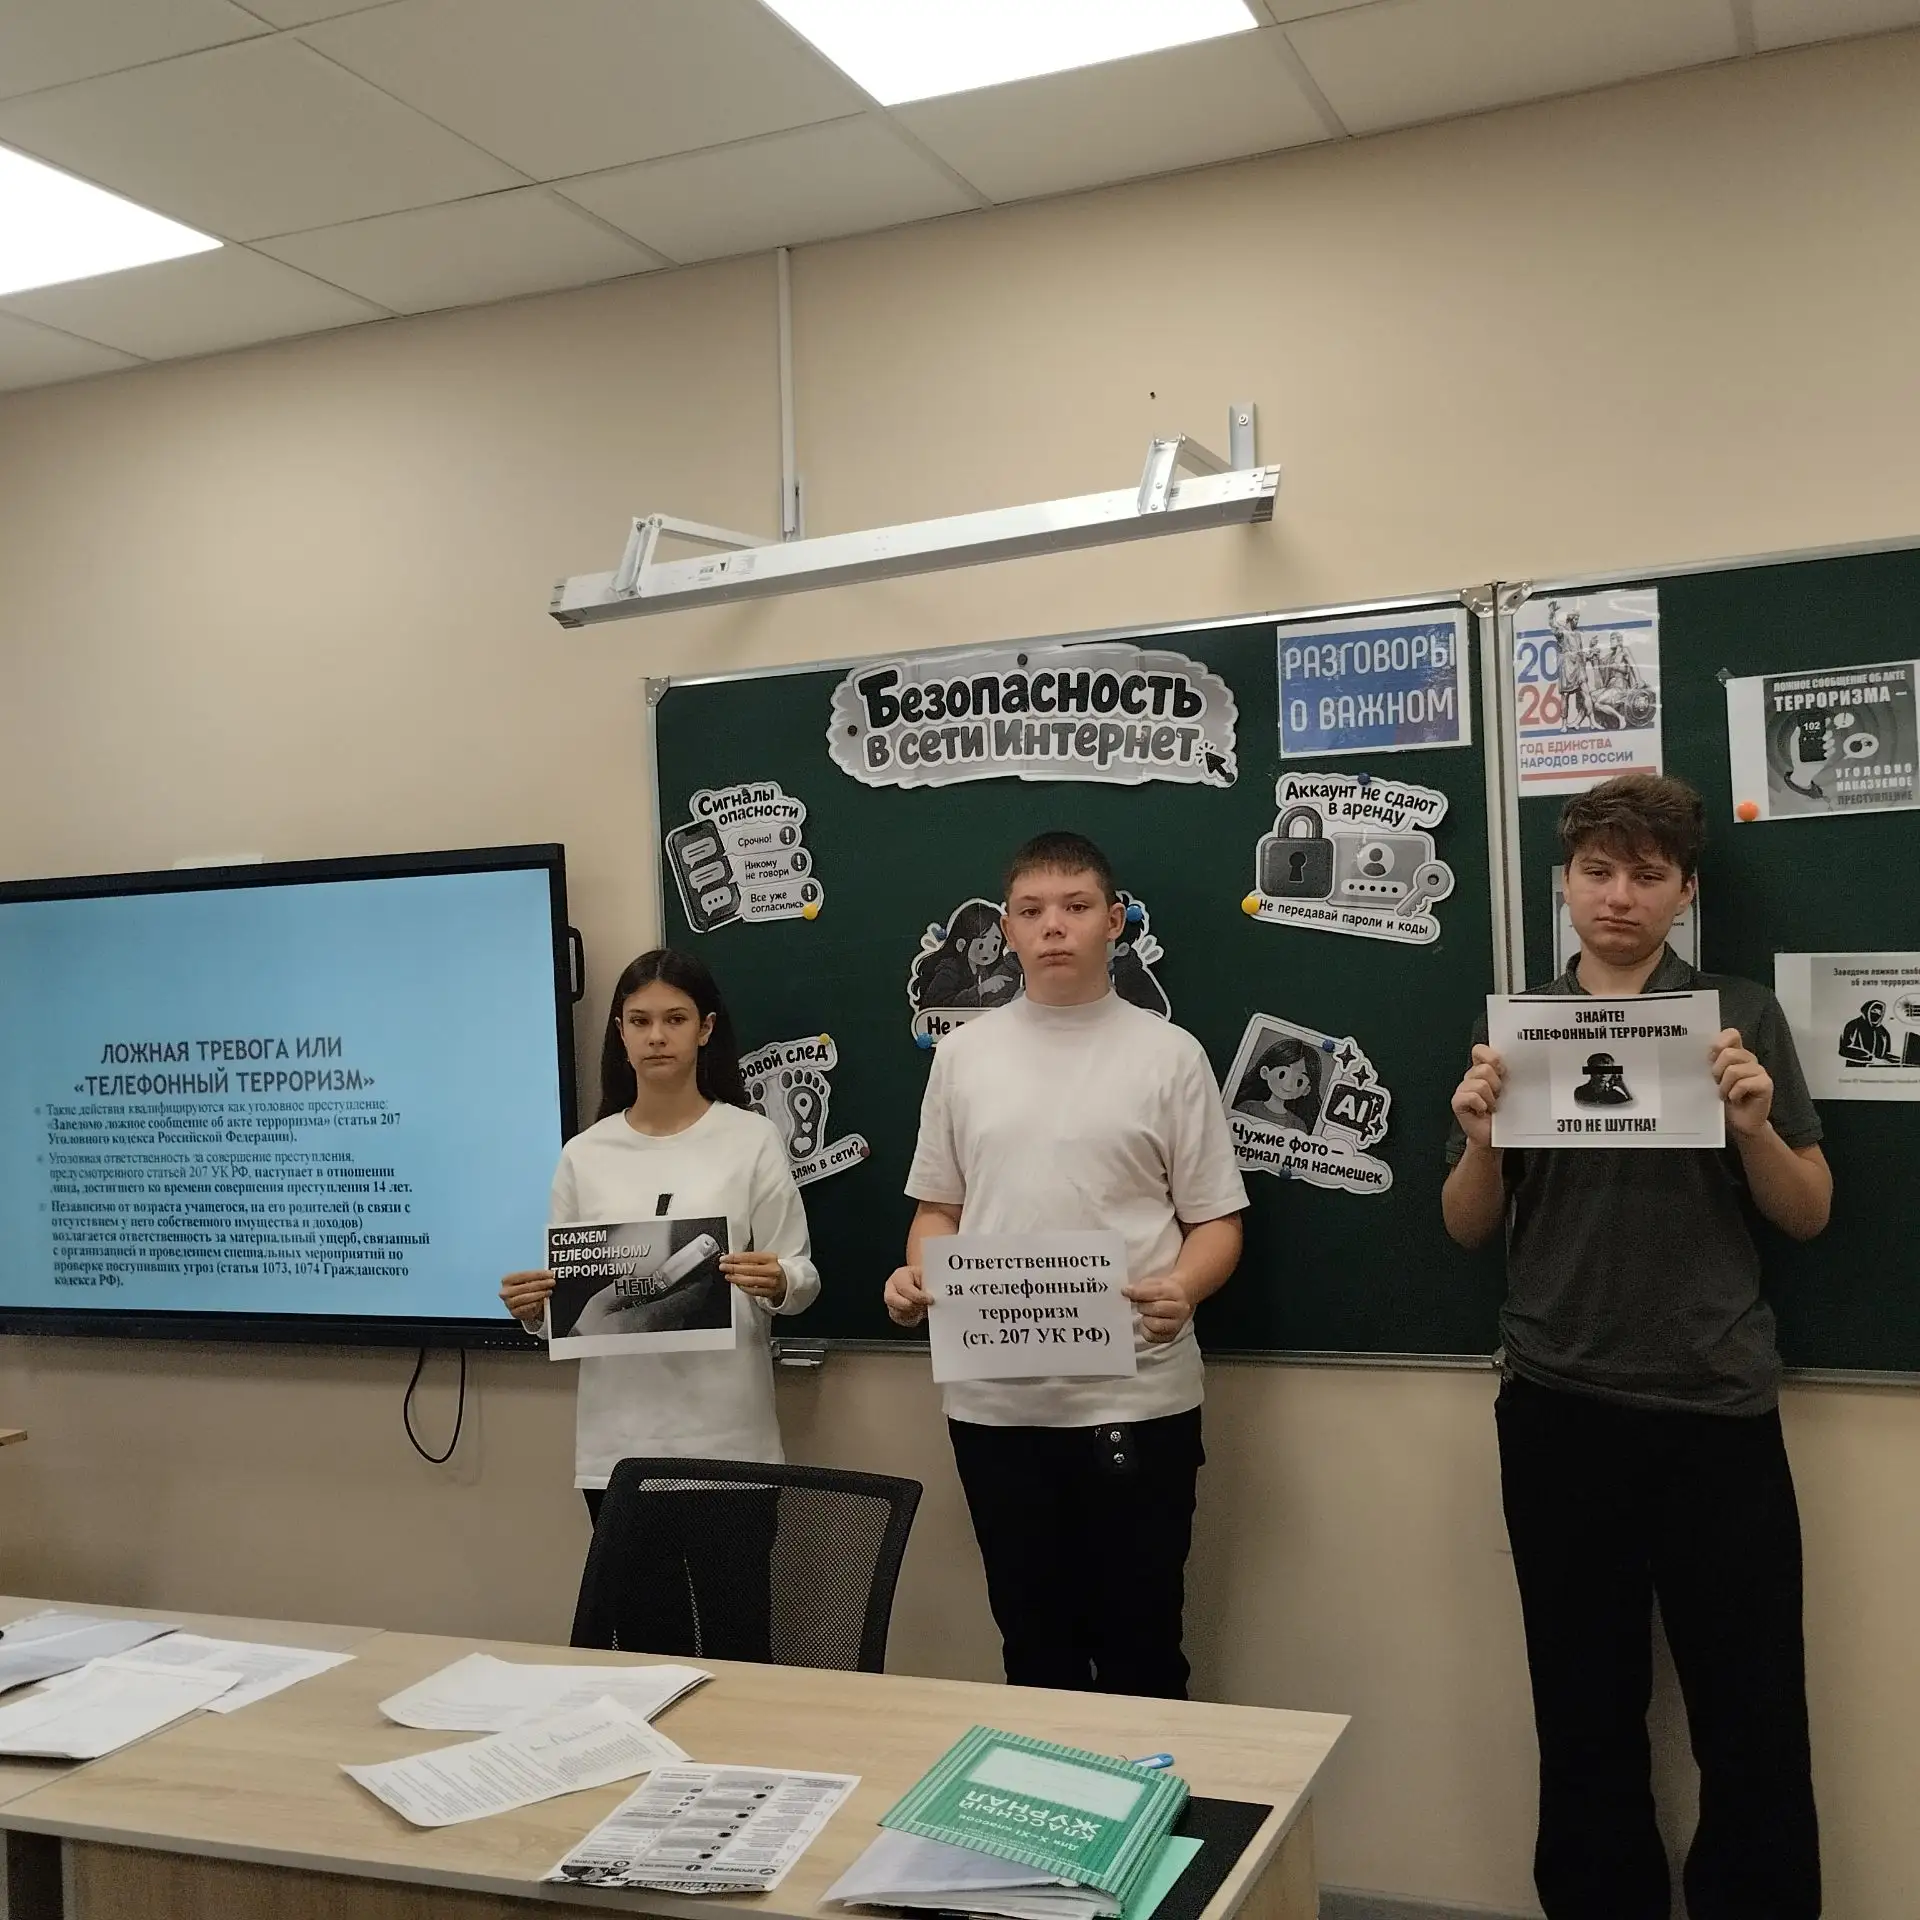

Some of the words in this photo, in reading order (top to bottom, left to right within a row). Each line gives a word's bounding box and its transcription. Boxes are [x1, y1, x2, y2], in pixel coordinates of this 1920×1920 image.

[1285, 634, 1456, 680] РАЗГОВОРЫ
[1517, 639, 1560, 683] 20
[1812, 674, 1868, 689] СООБЩЕНИЕ
[1868, 672, 1882, 681] ОБ
[858, 669, 1204, 730] Безопасность
[1519, 683, 1562, 725] 26
[1774, 686, 1891, 712] ТЕРРОРИЗМА
[1290, 700, 1307, 732] О
[1320, 689, 1454, 730] ВАЖНОМ
[1803, 722, 1821, 731] 102
[866, 735, 890, 767] в
[900, 725, 985, 764] сети
[994, 719, 1200, 767] Интернет
[1520, 741, 1544, 754] ГОД
[1547, 738, 1612, 753] ЕДИНСТВА
[1521, 753, 1579, 768] НАРОДОВ
[1582, 750, 1634, 765] РОССИИ
[1835, 763, 1913, 779] УГОЛОВНО
[1836, 776, 1913, 792] НАКАЗУЕМОЕ
[698, 789, 775, 816] Сигналы
[1286, 781, 1357, 802] Аккаунт
[1361, 786, 1381, 801] не
[1384, 791, 1438, 815] сдают
[718, 804, 799, 825] опасности
[1328, 803, 1337, 815] в
[1342, 802, 1406, 828] аренду
[737, 833, 772, 848] Срочно!
[744, 859, 778, 872] Никому
[745, 870, 756, 880] не
[758, 868, 790, 881] говори
[750, 893, 767, 902] Все
[769, 891, 788, 903] уже
[751, 901, 805, 914] согласились
[1259, 900, 1274, 912] Не
[1278, 903, 1338, 922] передавай
[1342, 913, 1382, 928] пароли
[1387, 921, 1393, 929] и
[1399, 921, 1428, 935] коды
[1851, 978, 1860, 986] об
[1575, 1009, 1625, 1024] ЗНАЙТЕ!
[927, 1016, 950, 1036] Не
[1517, 1025, 1608, 1041] «ТЕЛЕФОННЫЙ
[1609, 1025, 1688, 1039] ТЕРРОРИЗМ»
[101, 1041, 189, 1064] ЛОЖНАЯ
[196, 1038, 289, 1061] ТРЕВОГА
[296, 1036, 342, 1059] ИЛИ
[786, 1045, 828, 1063] след
[74, 1067, 229, 1096] «ТЕЛЕФОННЫЙ
[236, 1069, 375, 1094] ТЕРРОРИЗМ»
[78, 1103, 125, 1116] действия
[128, 1101, 224, 1117] квалифицируются
[228, 1102, 245, 1112] как
[249, 1102, 305, 1115] уголовное
[1333, 1094, 1369, 1123] AI
[104, 1118, 145, 1129] ложное
[148, 1117, 208, 1130] сообщение
[211, 1116, 223, 1128] об
[227, 1117, 252, 1127] акте
[255, 1116, 331, 1130] терроризма»
[333, 1115, 377, 1127] (статья
[381, 1113, 401, 1125] 207
[1557, 1118, 1582, 1133] ЭТО
[1585, 1118, 1602, 1132] НЕ
[1605, 1118, 1656, 1132] ШУТКА!
[48, 1133, 110, 1145] Уголовного
[112, 1134, 154, 1145] кодекса
[158, 1131, 222, 1144] Российской
[225, 1131, 298, 1145] Федерации).
[1232, 1122, 1285, 1148] Чужие
[1289, 1134, 1329, 1157] фото
[49, 1153, 101, 1164] Уголовная
[104, 1153, 190, 1164] ответственность
[206, 1153, 272, 1165] совершение
[275, 1152, 355, 1165] преступления,
[820, 1159, 827, 1169] в
[830, 1141, 860, 1165] сети?
[50, 1168, 144, 1181] предусмотренного
[147, 1167, 186, 1178] статьей
[189, 1166, 208, 1177] 207
[211, 1167, 229, 1177] УК
[255, 1167, 312, 1180] наступает
[316, 1168, 323, 1177] в
[327, 1167, 394, 1178] отношении
[1282, 1155, 1308, 1170] для
[1312, 1160, 1383, 1185] насмешек
[83, 1183, 144, 1194] достигшего
[148, 1184, 161, 1193] ко
[164, 1183, 212, 1195] времени
[214, 1183, 284, 1195] совершения
[287, 1182, 370, 1196] преступления
[373, 1181, 385, 1192] 14
[389, 1182, 413, 1193] лет.
[52, 1201, 116, 1212] Независимо
[118, 1203, 130, 1212] от
[133, 1203, 182, 1215] возраста
[184, 1203, 248, 1215] учащегося,
[251, 1203, 265, 1213] на
[268, 1203, 286, 1213] его
[289, 1201, 350, 1215] родителей
[352, 1201, 365, 1214] (в
[367, 1203, 401, 1213] связи
[51, 1218, 119, 1229] отсутствием
[130, 1218, 154, 1228] него
[157, 1216, 232, 1229] собственного
[234, 1218, 299, 1230] имущества
[302, 1219, 310, 1228] и
[312, 1216, 363, 1229] доходов)
[52, 1231, 117, 1242] возлагается
[119, 1231, 212, 1243] ответственность
[215, 1233, 226, 1243] за
[230, 1231, 316, 1244] материальный
[319, 1232, 361, 1247] ущерб,
[363, 1232, 430, 1245] связанный
[551, 1230, 607, 1246] СКАЖЕМ
[61, 1245, 136, 1258] организацией
[139, 1247, 147, 1256] и
[149, 1247, 219, 1260] проведением
[223, 1248, 301, 1261] специальных
[305, 1248, 385, 1263] мероприятий
[388, 1251, 403, 1260] по
[551, 1244, 651, 1263] ТЕЛЕФОННОМУ
[948, 1254, 1111, 1270] Ответственность
[54, 1262, 101, 1274] проверке
[106, 1262, 181, 1275] поступивших
[183, 1263, 214, 1276] угроз
[217, 1262, 259, 1276] (статья
[262, 1262, 291, 1275] 1073,
[295, 1262, 320, 1275] 1074
[323, 1262, 409, 1278] Гражданского
[551, 1262, 637, 1279] ТЕРРОРИЗМУ
[54, 1276, 97, 1287] кодекса
[99, 1274, 124, 1288] РФ).
[614, 1277, 655, 1297] НЕТ!
[945, 1284, 963, 1296] за
[970, 1278, 1109, 1299] «телефонный»
[979, 1307, 1079, 1323] терроризм
[963, 1330, 994, 1348] (ст.
[1000, 1328, 1030, 1344] 207
[1036, 1328, 1067, 1344] УК
[1073, 1327, 1110, 1345] РФ)
[959, 1799, 1095, 1842] КЛАССНЫЙ
[965, 1790, 1102, 1835] ЖУРНАЛ
[958, 1814, 1012, 1831] классов
